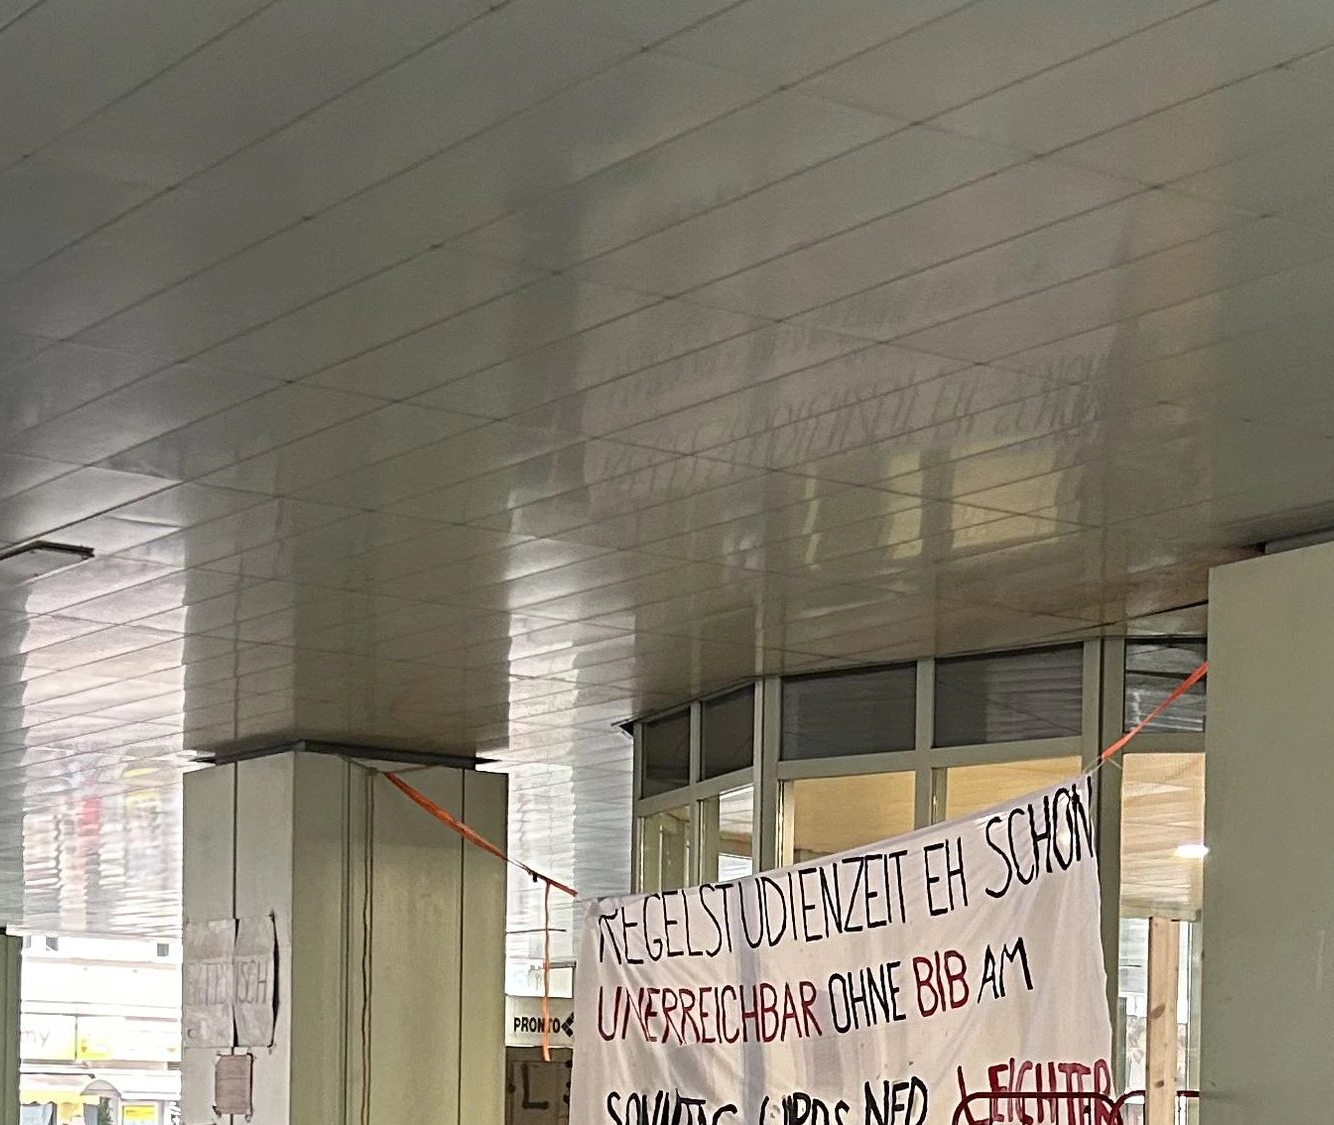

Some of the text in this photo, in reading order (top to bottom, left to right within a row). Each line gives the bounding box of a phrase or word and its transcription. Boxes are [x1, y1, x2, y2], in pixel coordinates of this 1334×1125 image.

[598, 775, 1095, 965] REGELSTUDIENZEIT EH SCHON
[597, 936, 1034, 1046] UNERREICHBAR OHNE BIB AM
